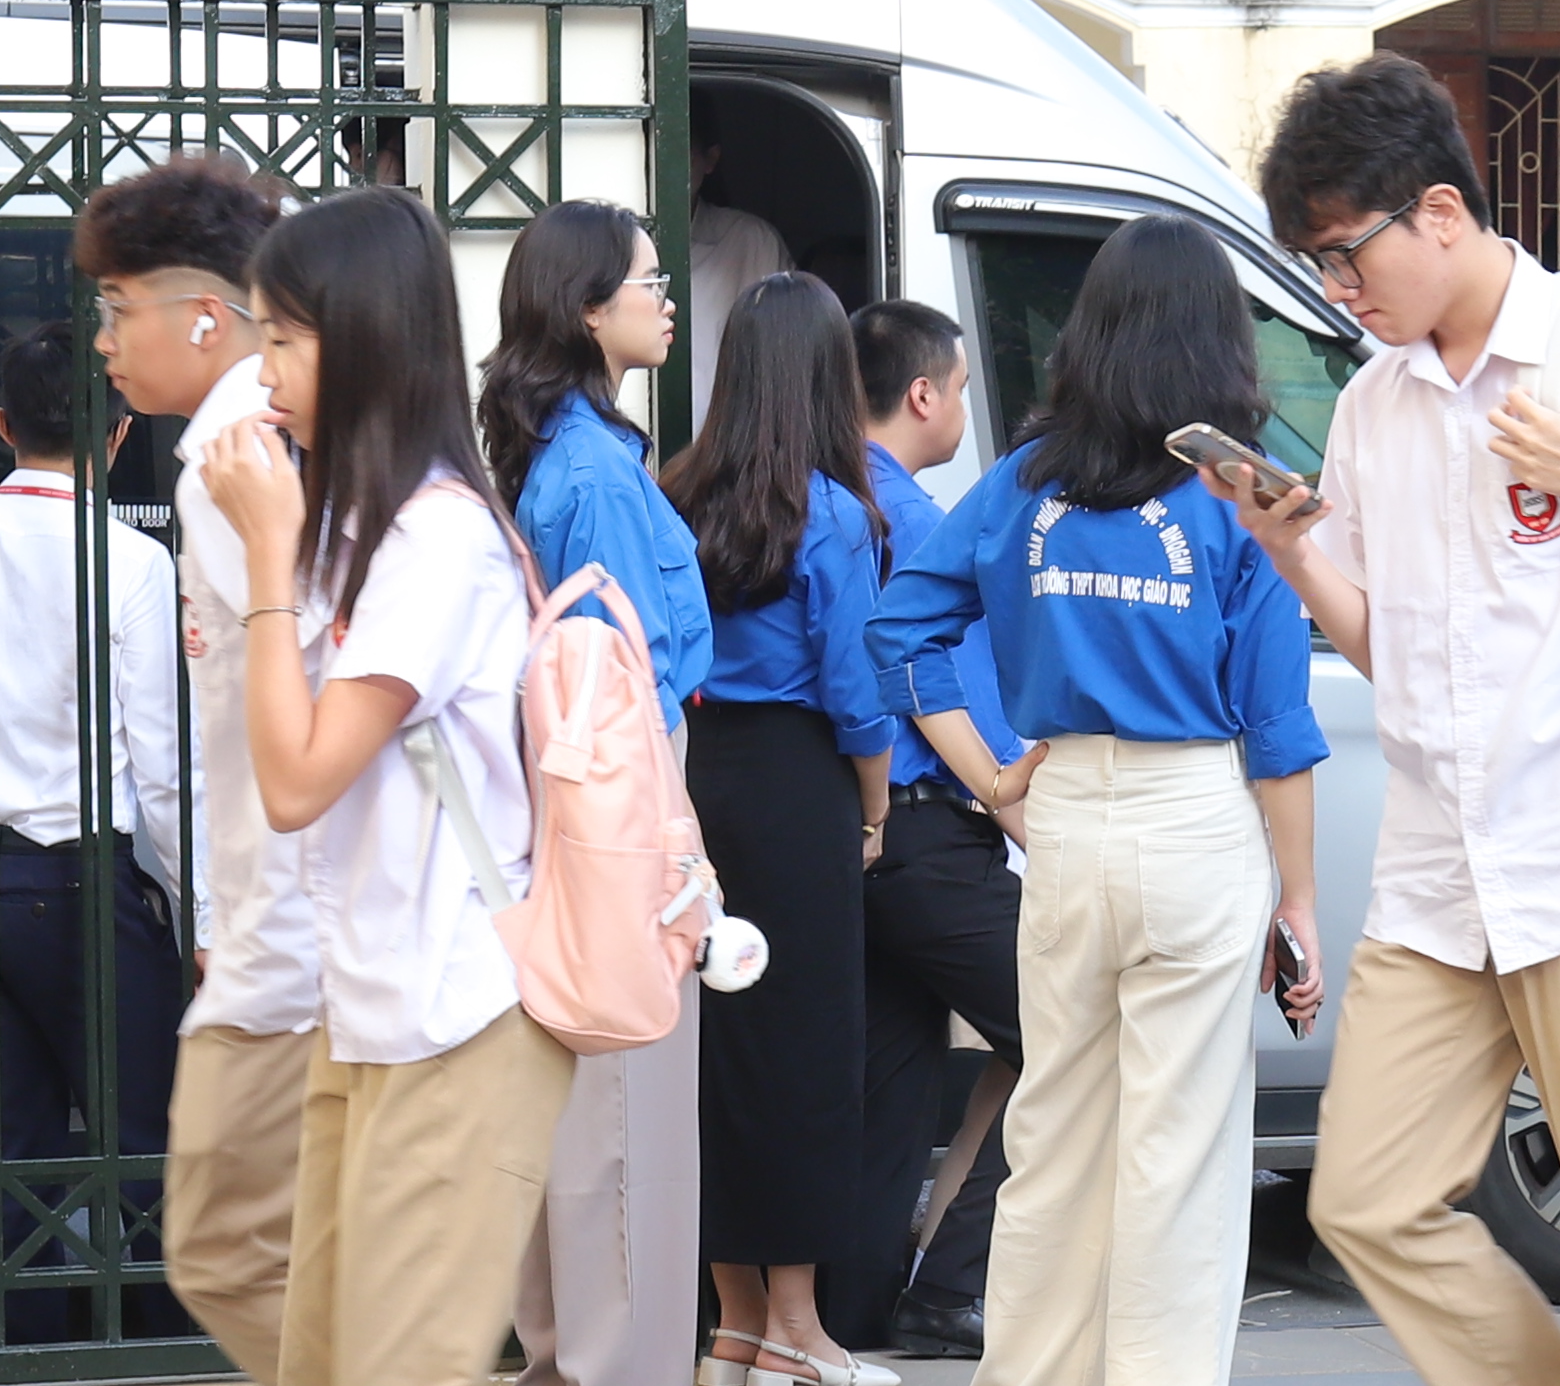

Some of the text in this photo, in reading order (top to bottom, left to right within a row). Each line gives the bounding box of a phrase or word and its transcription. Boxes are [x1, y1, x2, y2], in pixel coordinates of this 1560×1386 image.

[975, 196, 1035, 211] TRANSIT
[142, 518, 168, 528] DOOR
[1071, 571, 1094, 596] THPT
[1095, 573, 1119, 599] KHOA
[1121, 575, 1141, 607] HỌC
[1143, 574, 1168, 605] GIÁO
[1169, 583, 1191, 614] DỤC
